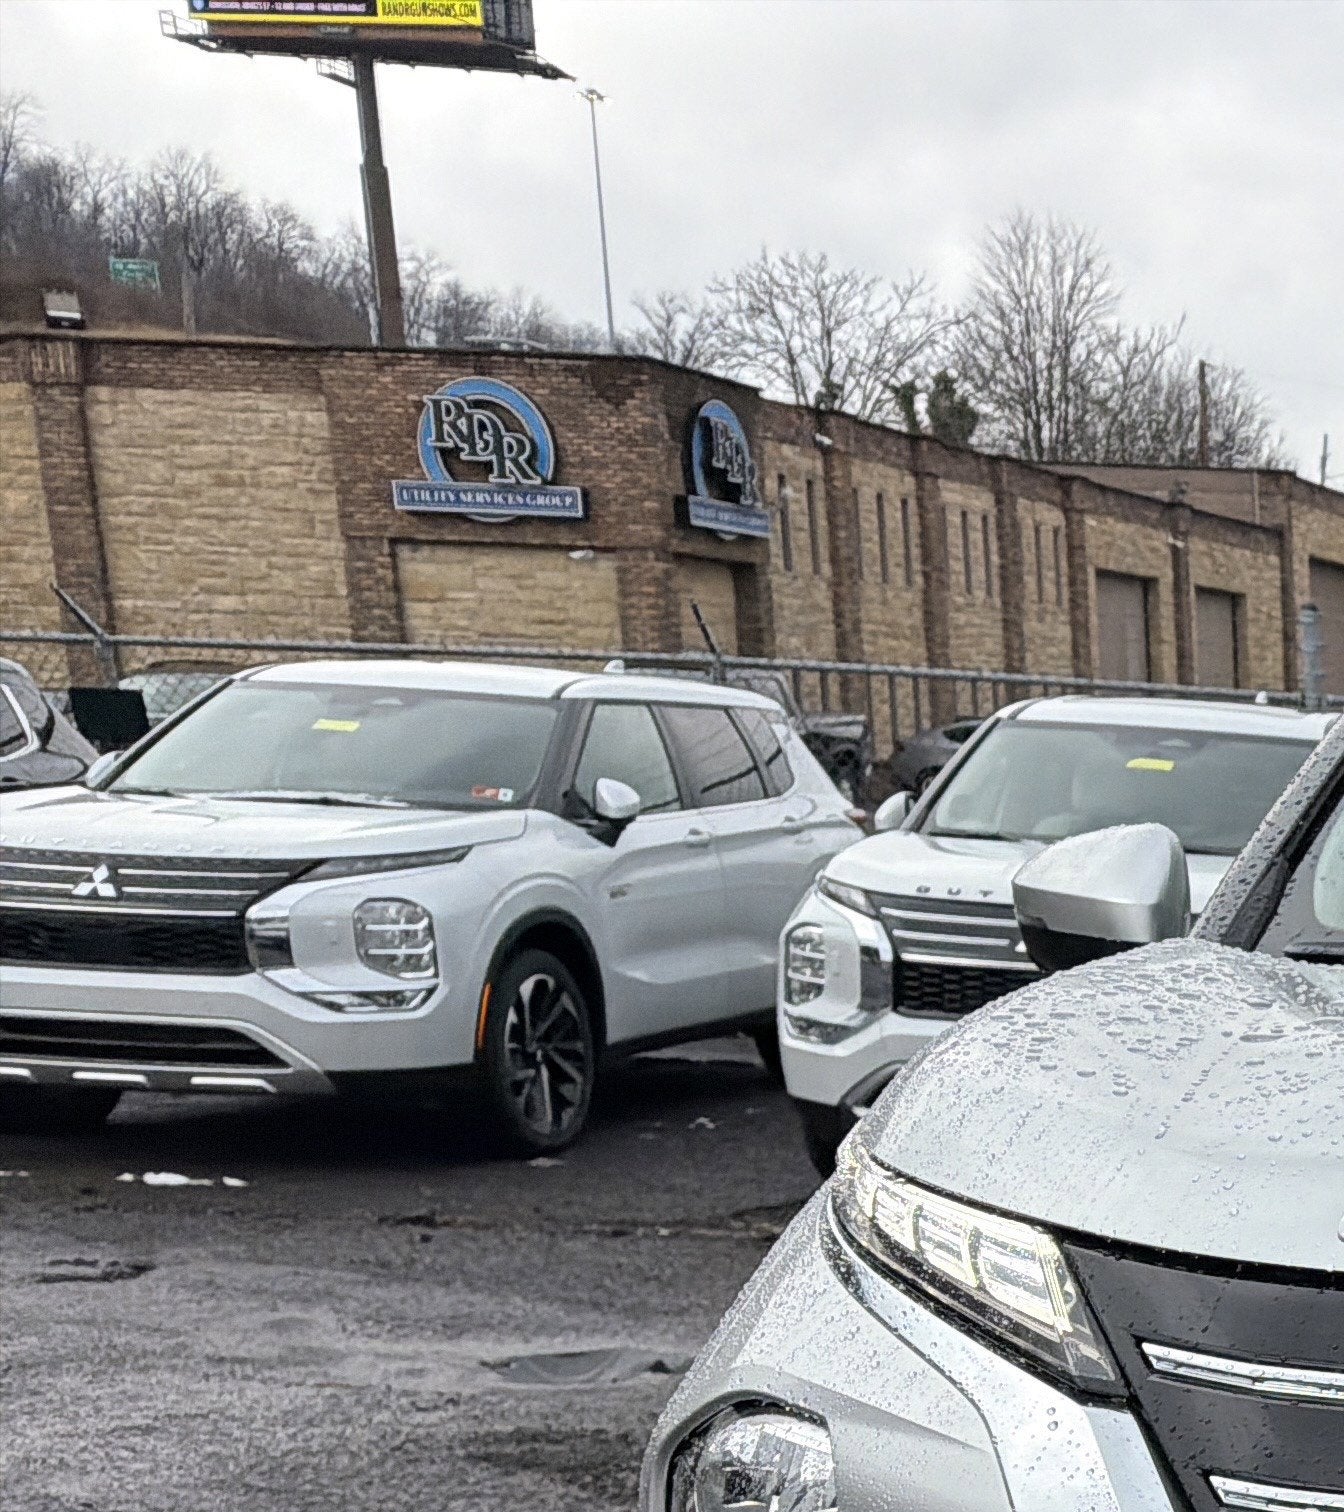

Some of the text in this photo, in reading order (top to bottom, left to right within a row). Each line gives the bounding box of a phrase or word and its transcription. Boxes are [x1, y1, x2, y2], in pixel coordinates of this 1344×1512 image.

[423, 395, 542, 485] RDR
[402, 488, 573, 507] UTILITY SERVICES GROUP
